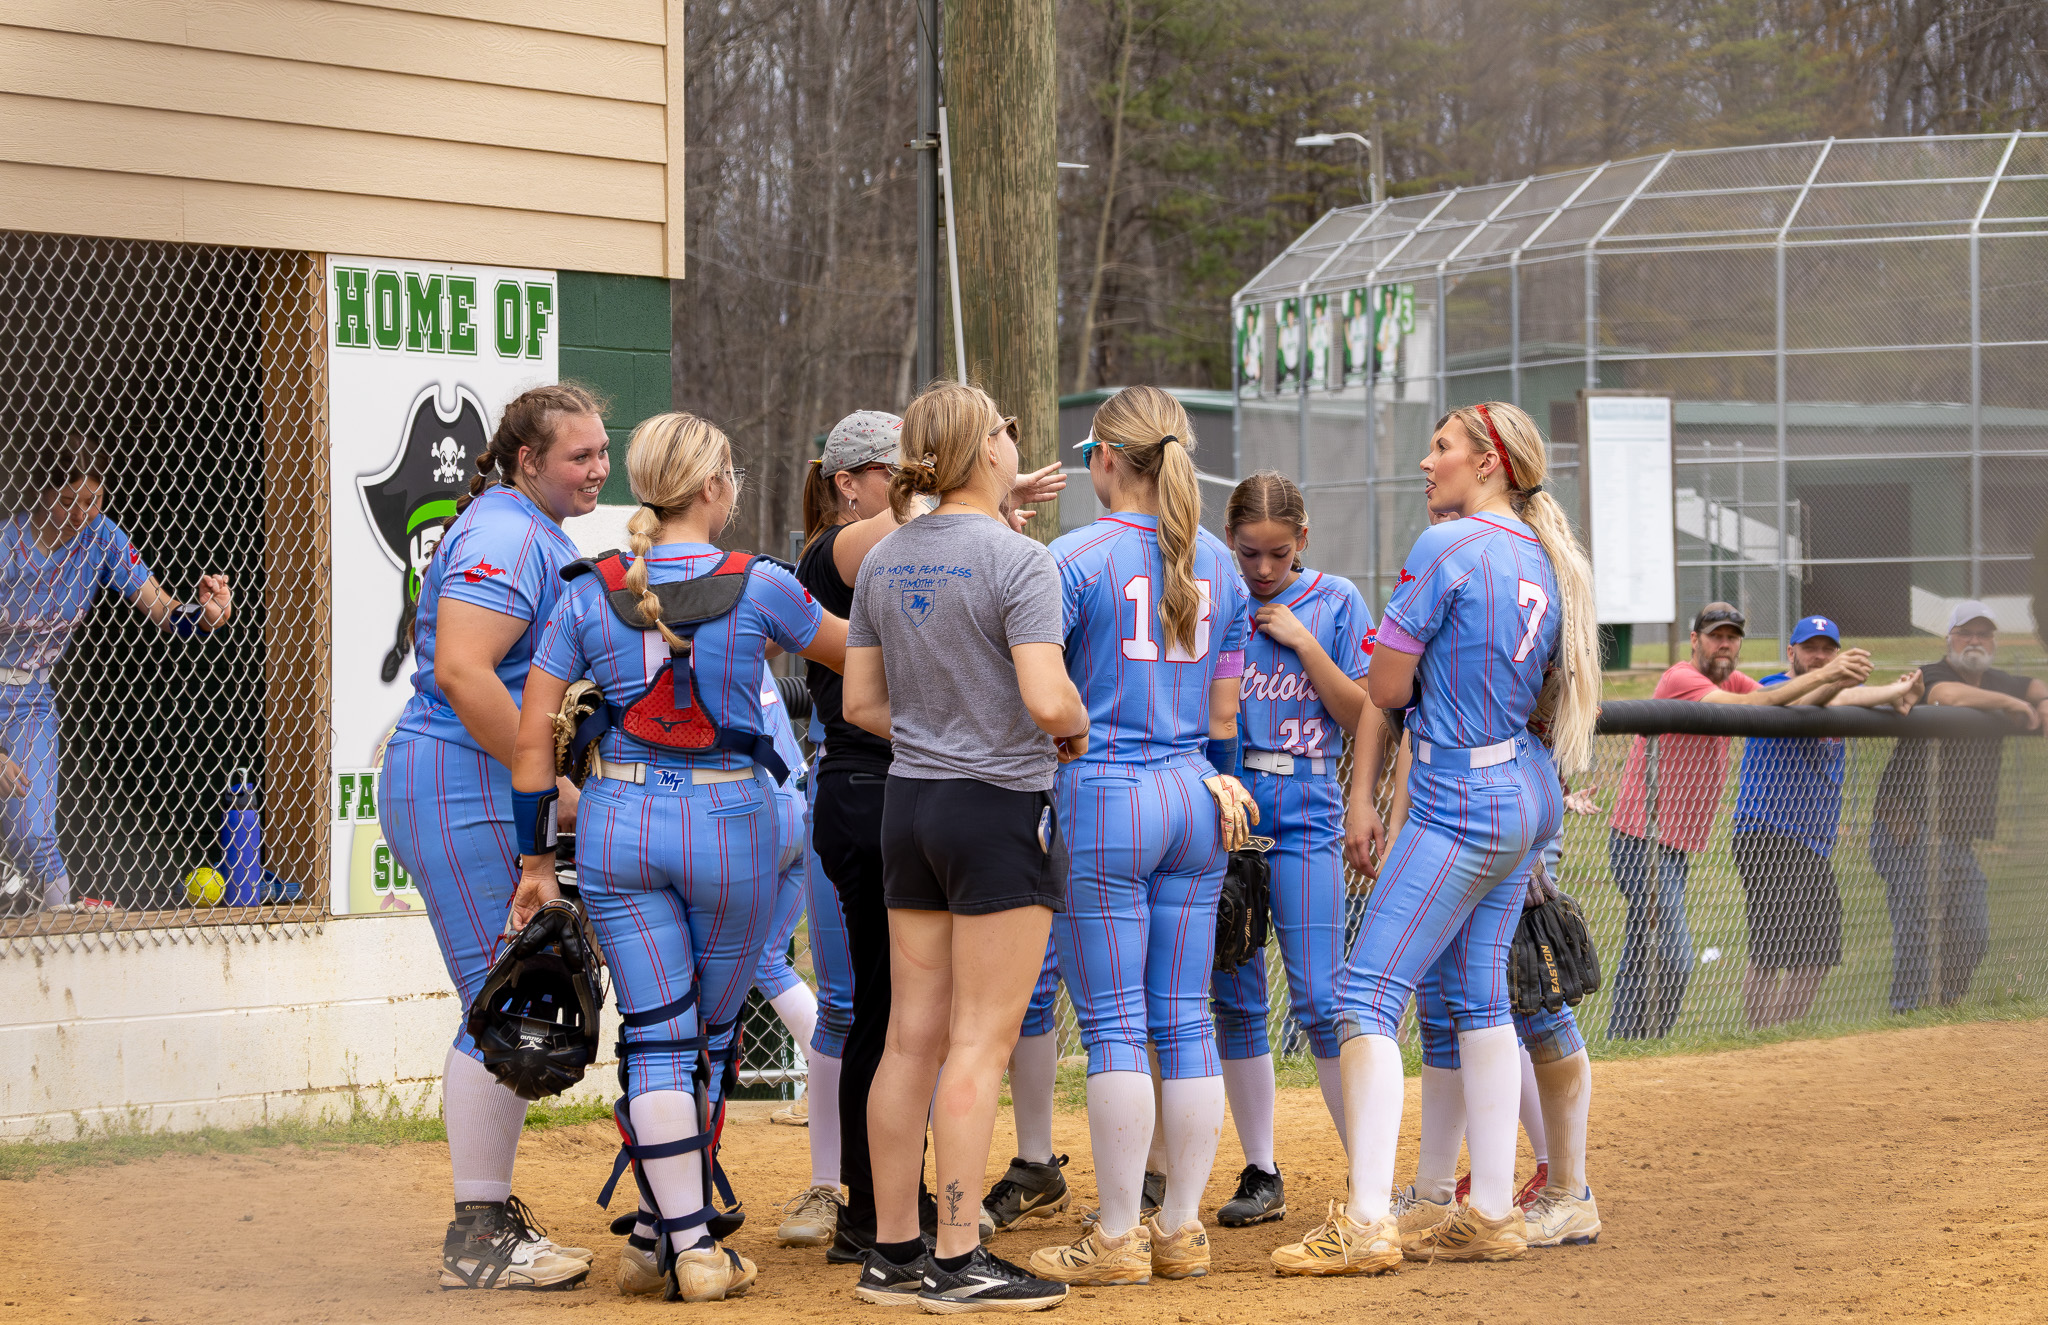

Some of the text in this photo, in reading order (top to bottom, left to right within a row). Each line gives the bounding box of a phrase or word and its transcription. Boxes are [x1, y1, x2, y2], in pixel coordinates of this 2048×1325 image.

[333, 266, 553, 360] HOME OF
[887, 565, 915, 576] MORE
[918, 565, 944, 575] FEAR
[946, 566, 972, 578] LESS
[888, 579, 894, 589] 2
[899, 579, 935, 590] TIMOTHY
[1511, 578, 1549, 663] 7
[1811, 618, 1828, 631] T
[1239, 661, 1319, 702] triots
[1278, 717, 1326, 758] 22
[653, 769, 686, 792] MT
[1541, 945, 1561, 994] EASTON
